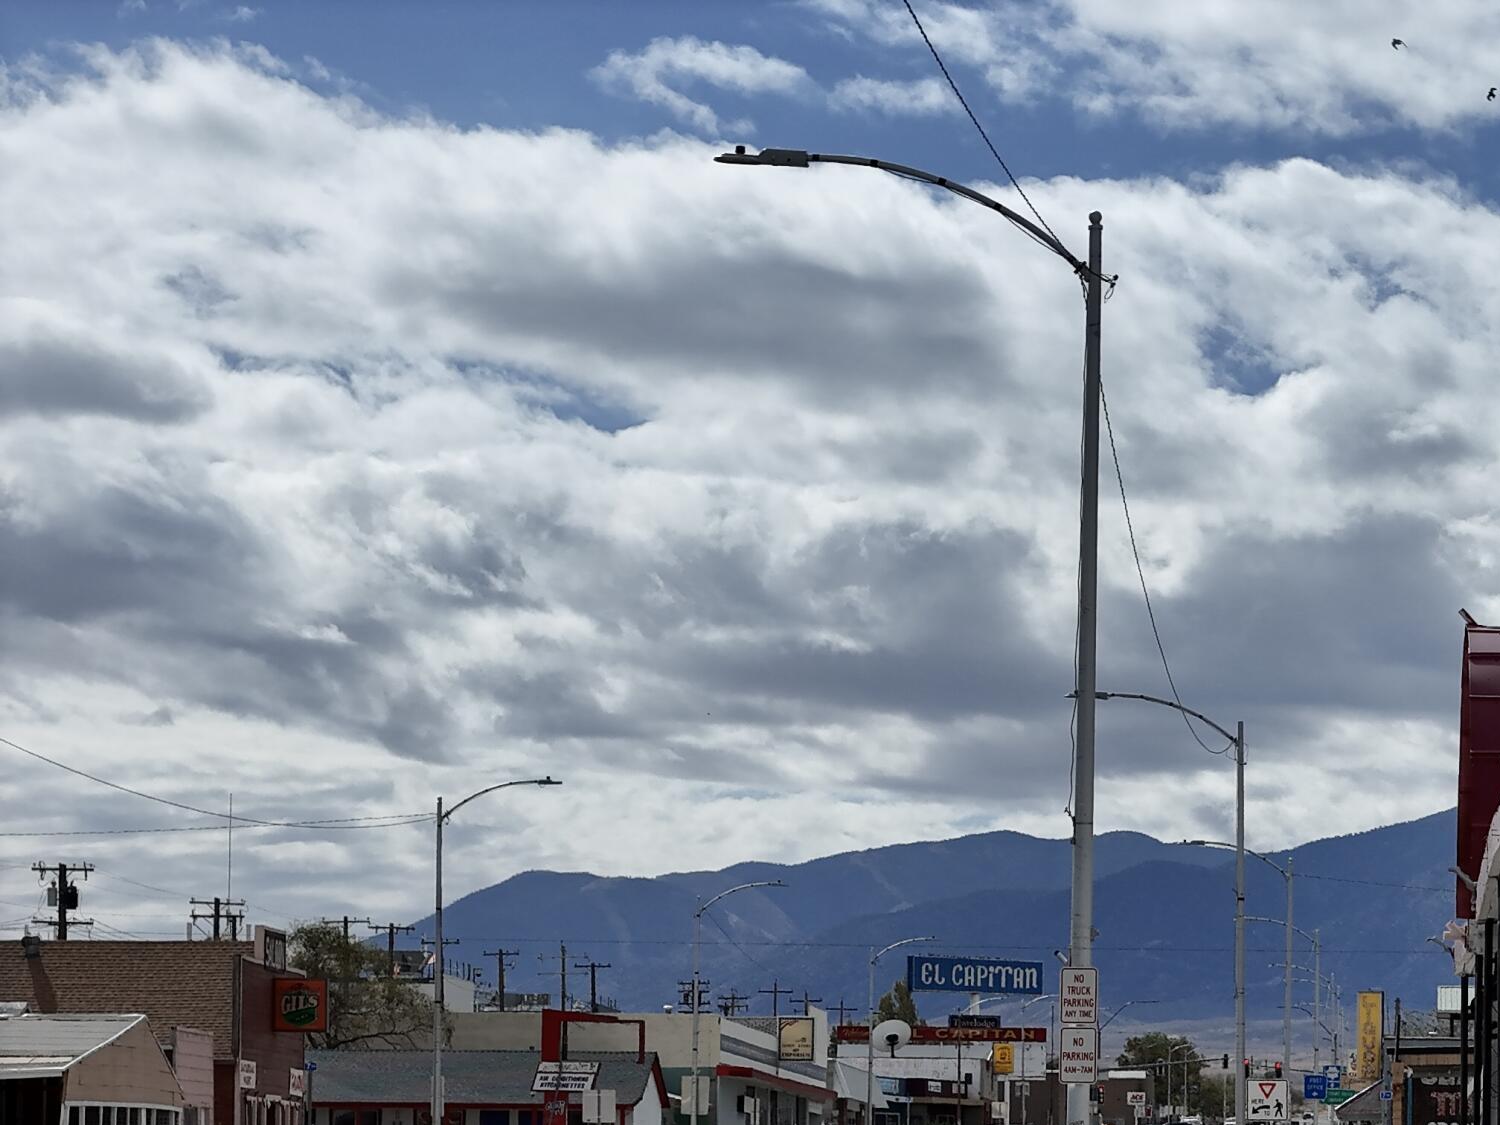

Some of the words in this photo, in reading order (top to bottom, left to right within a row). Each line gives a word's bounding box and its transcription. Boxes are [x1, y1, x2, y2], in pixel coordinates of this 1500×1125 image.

[921, 962, 945, 985] EL
[952, 964, 1038, 989] CAPITAN
[1073, 974, 1085, 984] NO
[1067, 985, 1091, 996] TRUCK
[1063, 998, 1095, 1008] PARKING
[1064, 1010, 1077, 1018] ANY
[1079, 1010, 1093, 1018] TIME
[935, 1028, 1035, 1040] CAPITAN
[1072, 1037, 1084, 1047] NO
[1062, 1051, 1094, 1061] PARKING
[1064, 1065, 1093, 1073] 4AM-7AM
